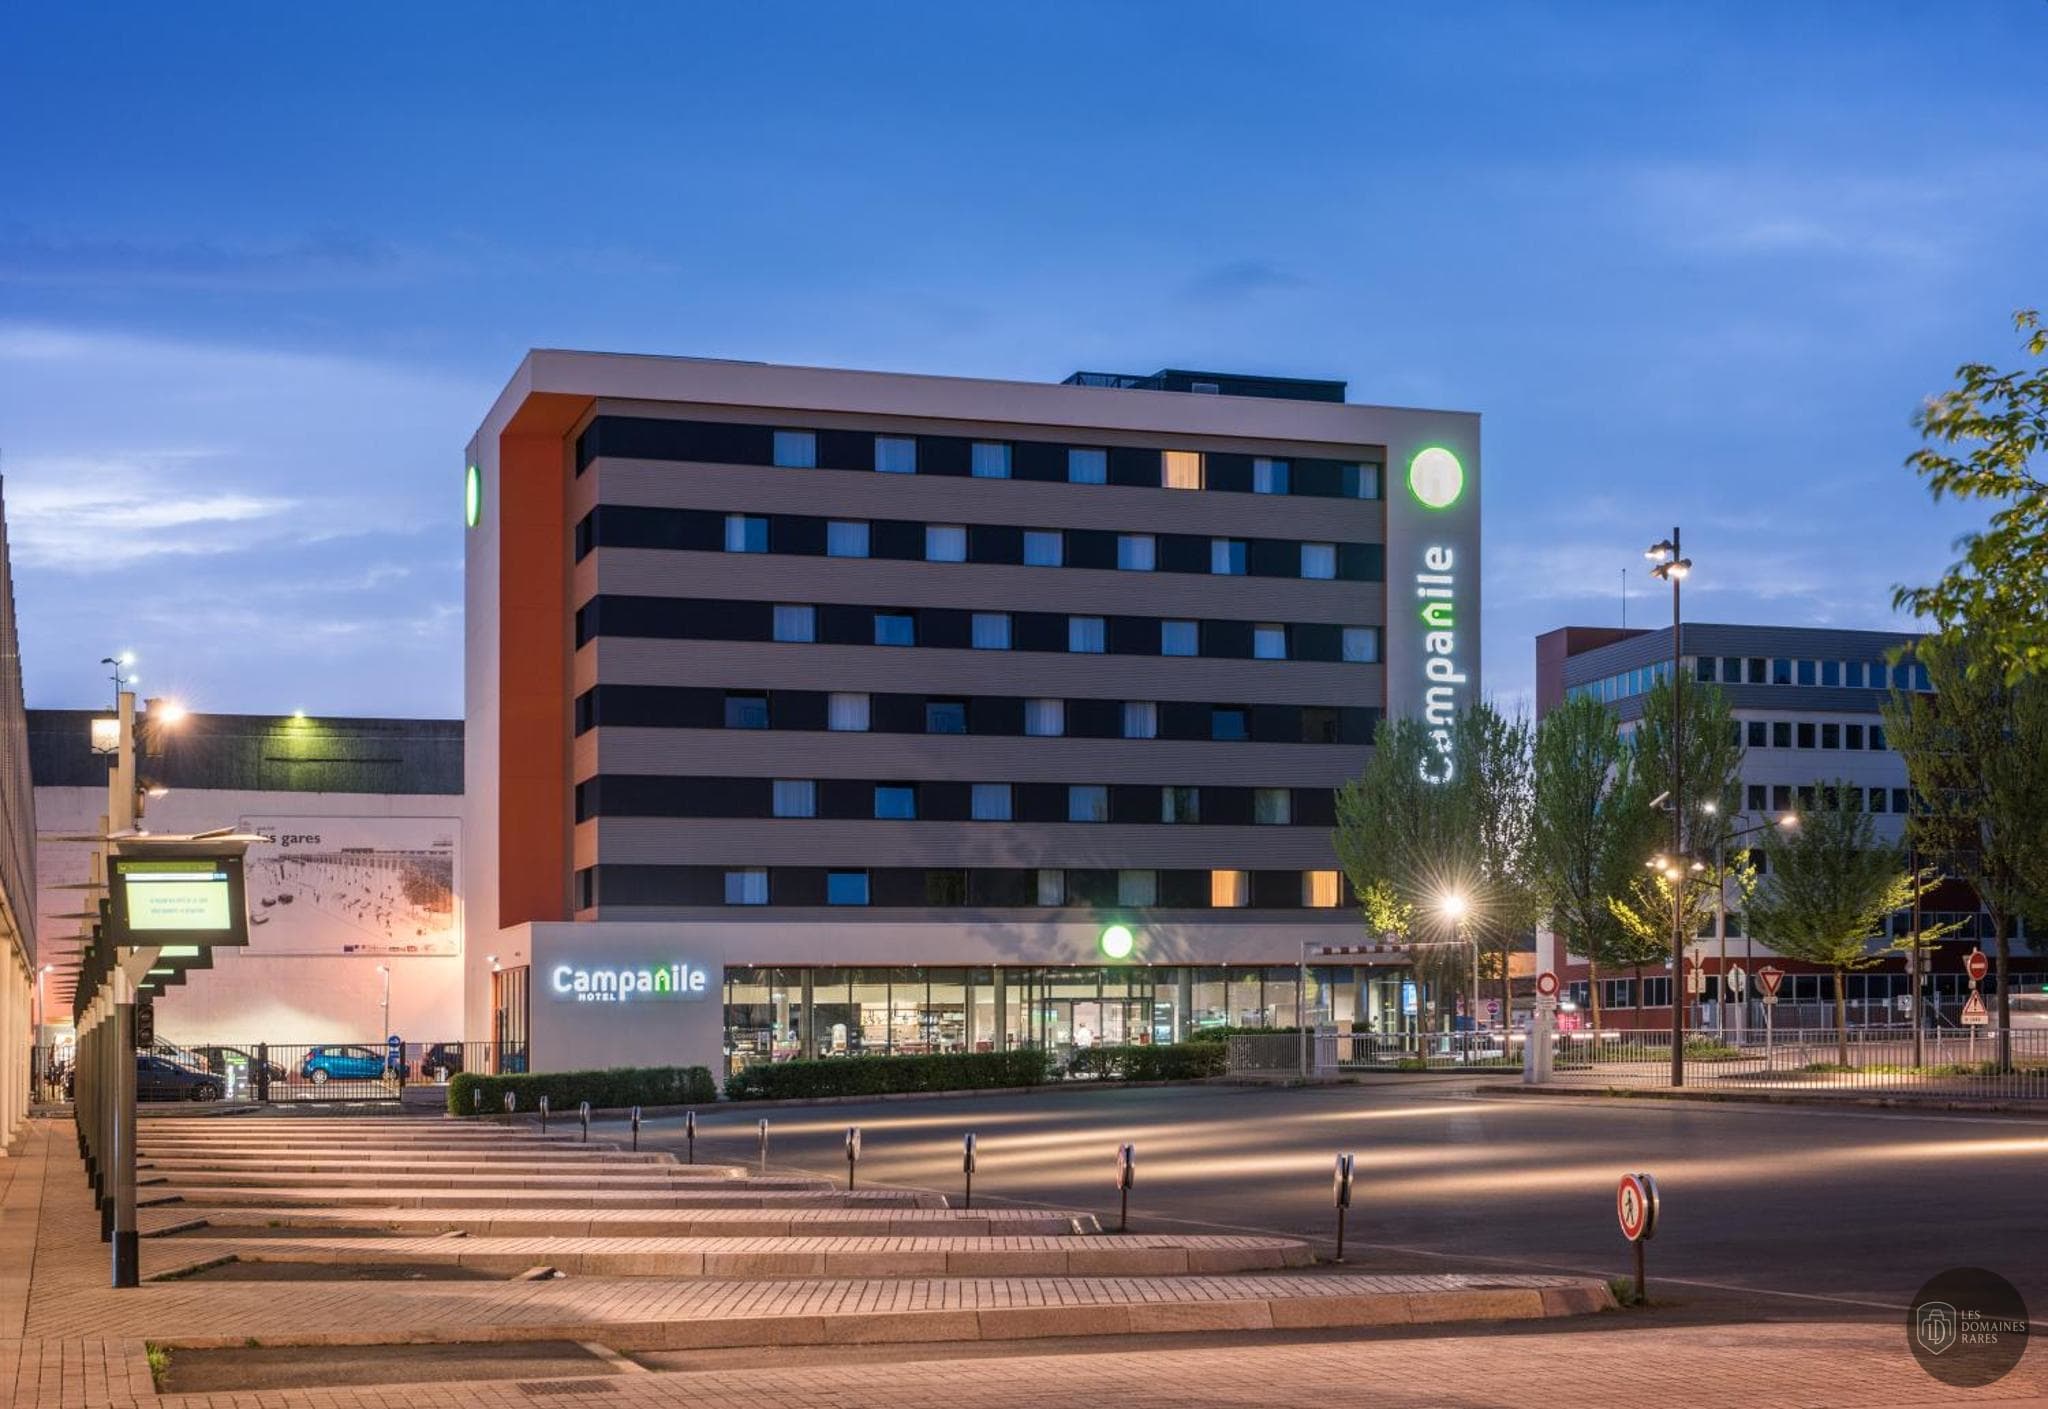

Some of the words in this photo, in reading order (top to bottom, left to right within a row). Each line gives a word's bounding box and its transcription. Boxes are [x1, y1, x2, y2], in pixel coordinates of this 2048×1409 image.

[1416, 545, 1466, 784] Campanile
[281, 834, 321, 847] gares
[552, 963, 706, 1001] Campanile
[578, 992, 617, 1001] HOTEL
